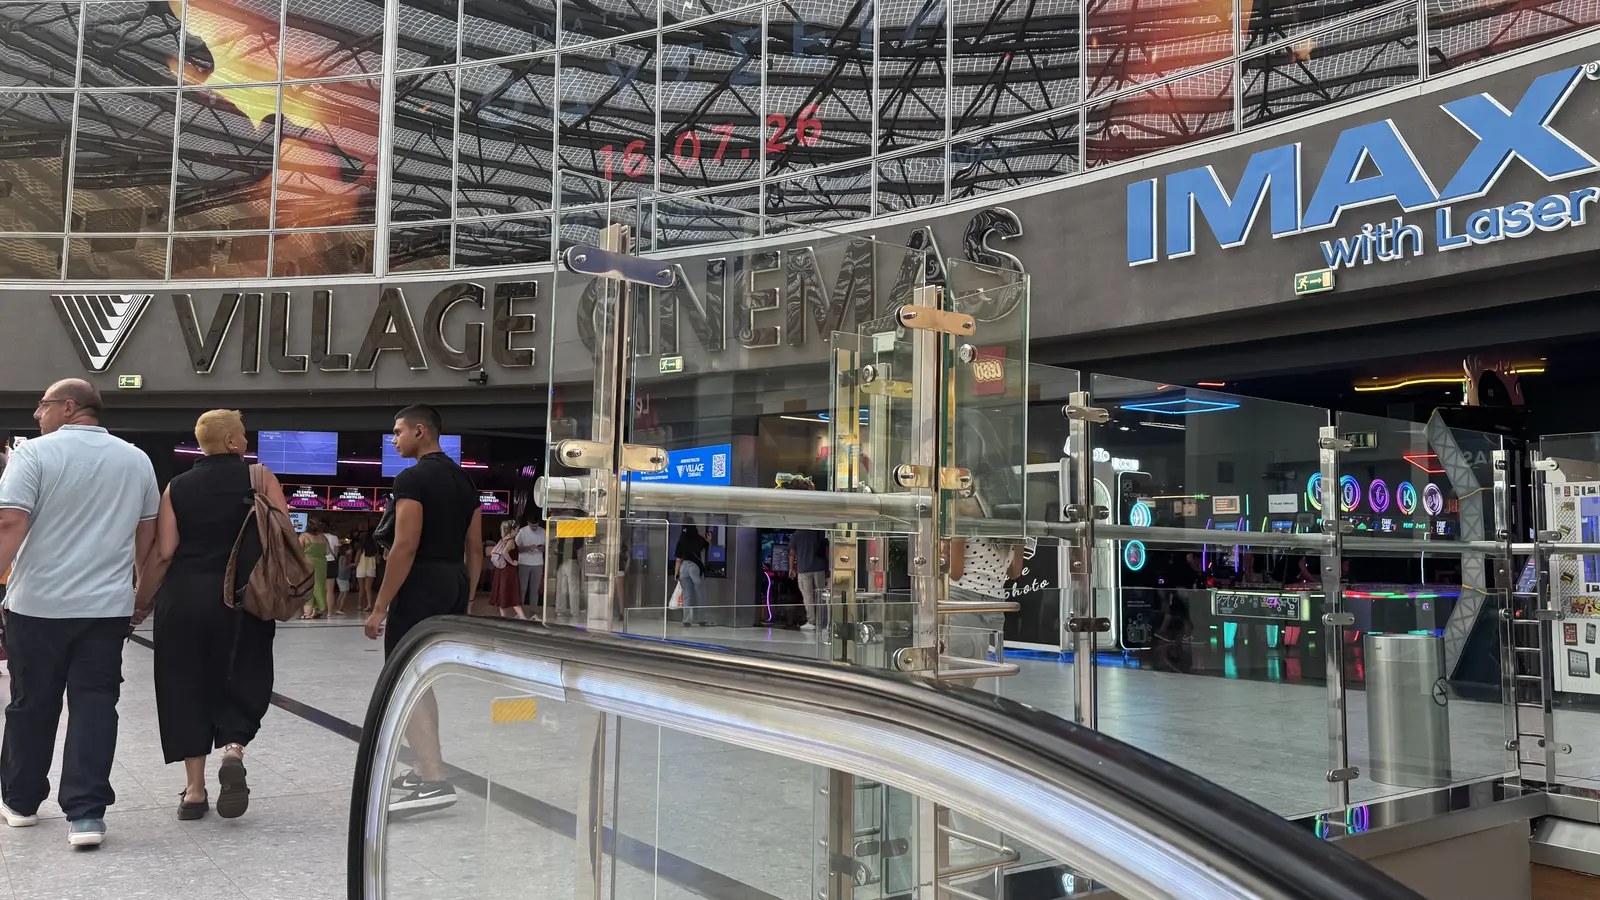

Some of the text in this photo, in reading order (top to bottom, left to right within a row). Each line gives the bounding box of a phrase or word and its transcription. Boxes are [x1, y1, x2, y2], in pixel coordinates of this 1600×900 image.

[600, 104, 823, 181] 16.07.26
[1320, 186, 1599, 270] with Laser
[171, 206, 1024, 374] VILLAGE CINEMAS
[685, 463, 705, 472] VILLAGE
